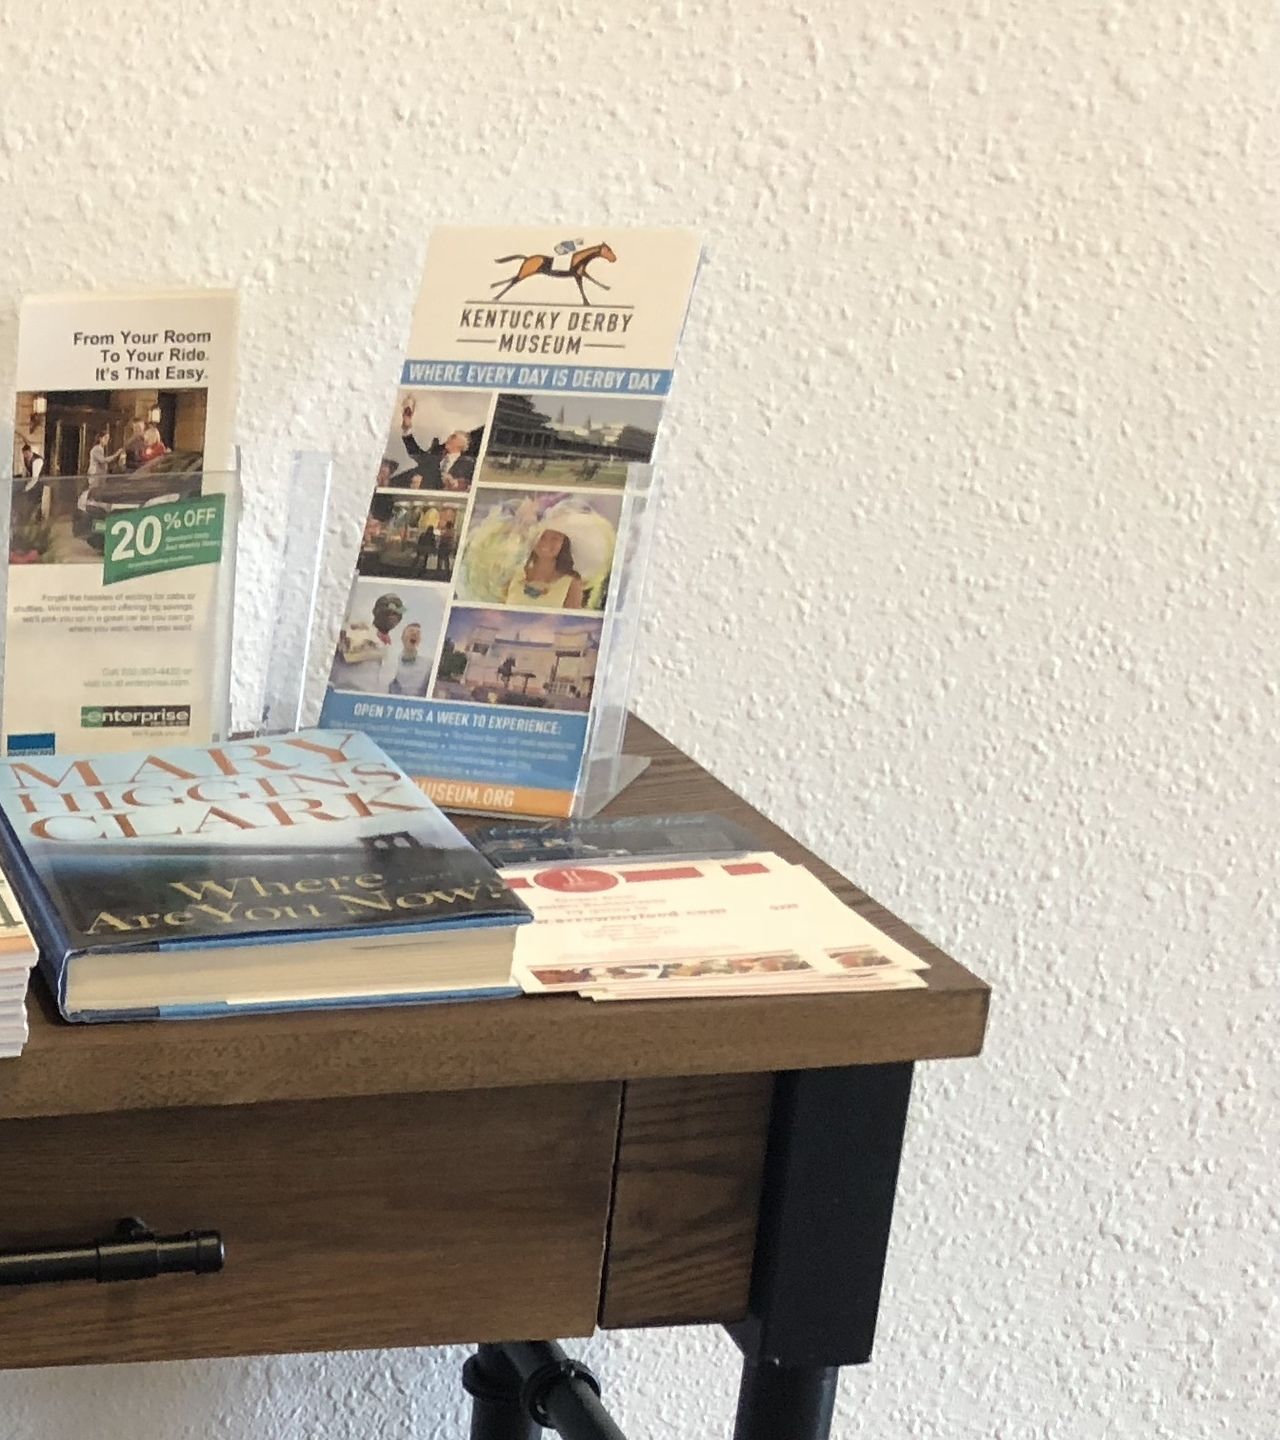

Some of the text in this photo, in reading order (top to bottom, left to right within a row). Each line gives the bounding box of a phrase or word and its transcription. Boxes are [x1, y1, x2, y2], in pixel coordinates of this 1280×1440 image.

[459, 308, 633, 333] KENTUCKY DERBY
[73, 329, 211, 345] From Your Room
[498, 334, 582, 355] MUSEUM
[100, 347, 209, 363] To Your Ride.
[96, 366, 208, 382] It's That Easy.
[409, 364, 662, 391] WHERE EVERY DAY IS DERBY DAY
[184, 507, 216, 527] OFF
[85, 708, 189, 724] enterprise
[354, 703, 384, 717] OPEN
[395, 708, 424, 722] DAYS
[426, 710, 434, 723] A
[437, 711, 468, 727] WEEK
[473, 715, 486, 728] TO
[9, 733, 356, 789] MARY
[14, 762, 403, 814] HIGGINS
[30, 786, 426, 841] CLARK
[170, 871, 385, 901] Where
